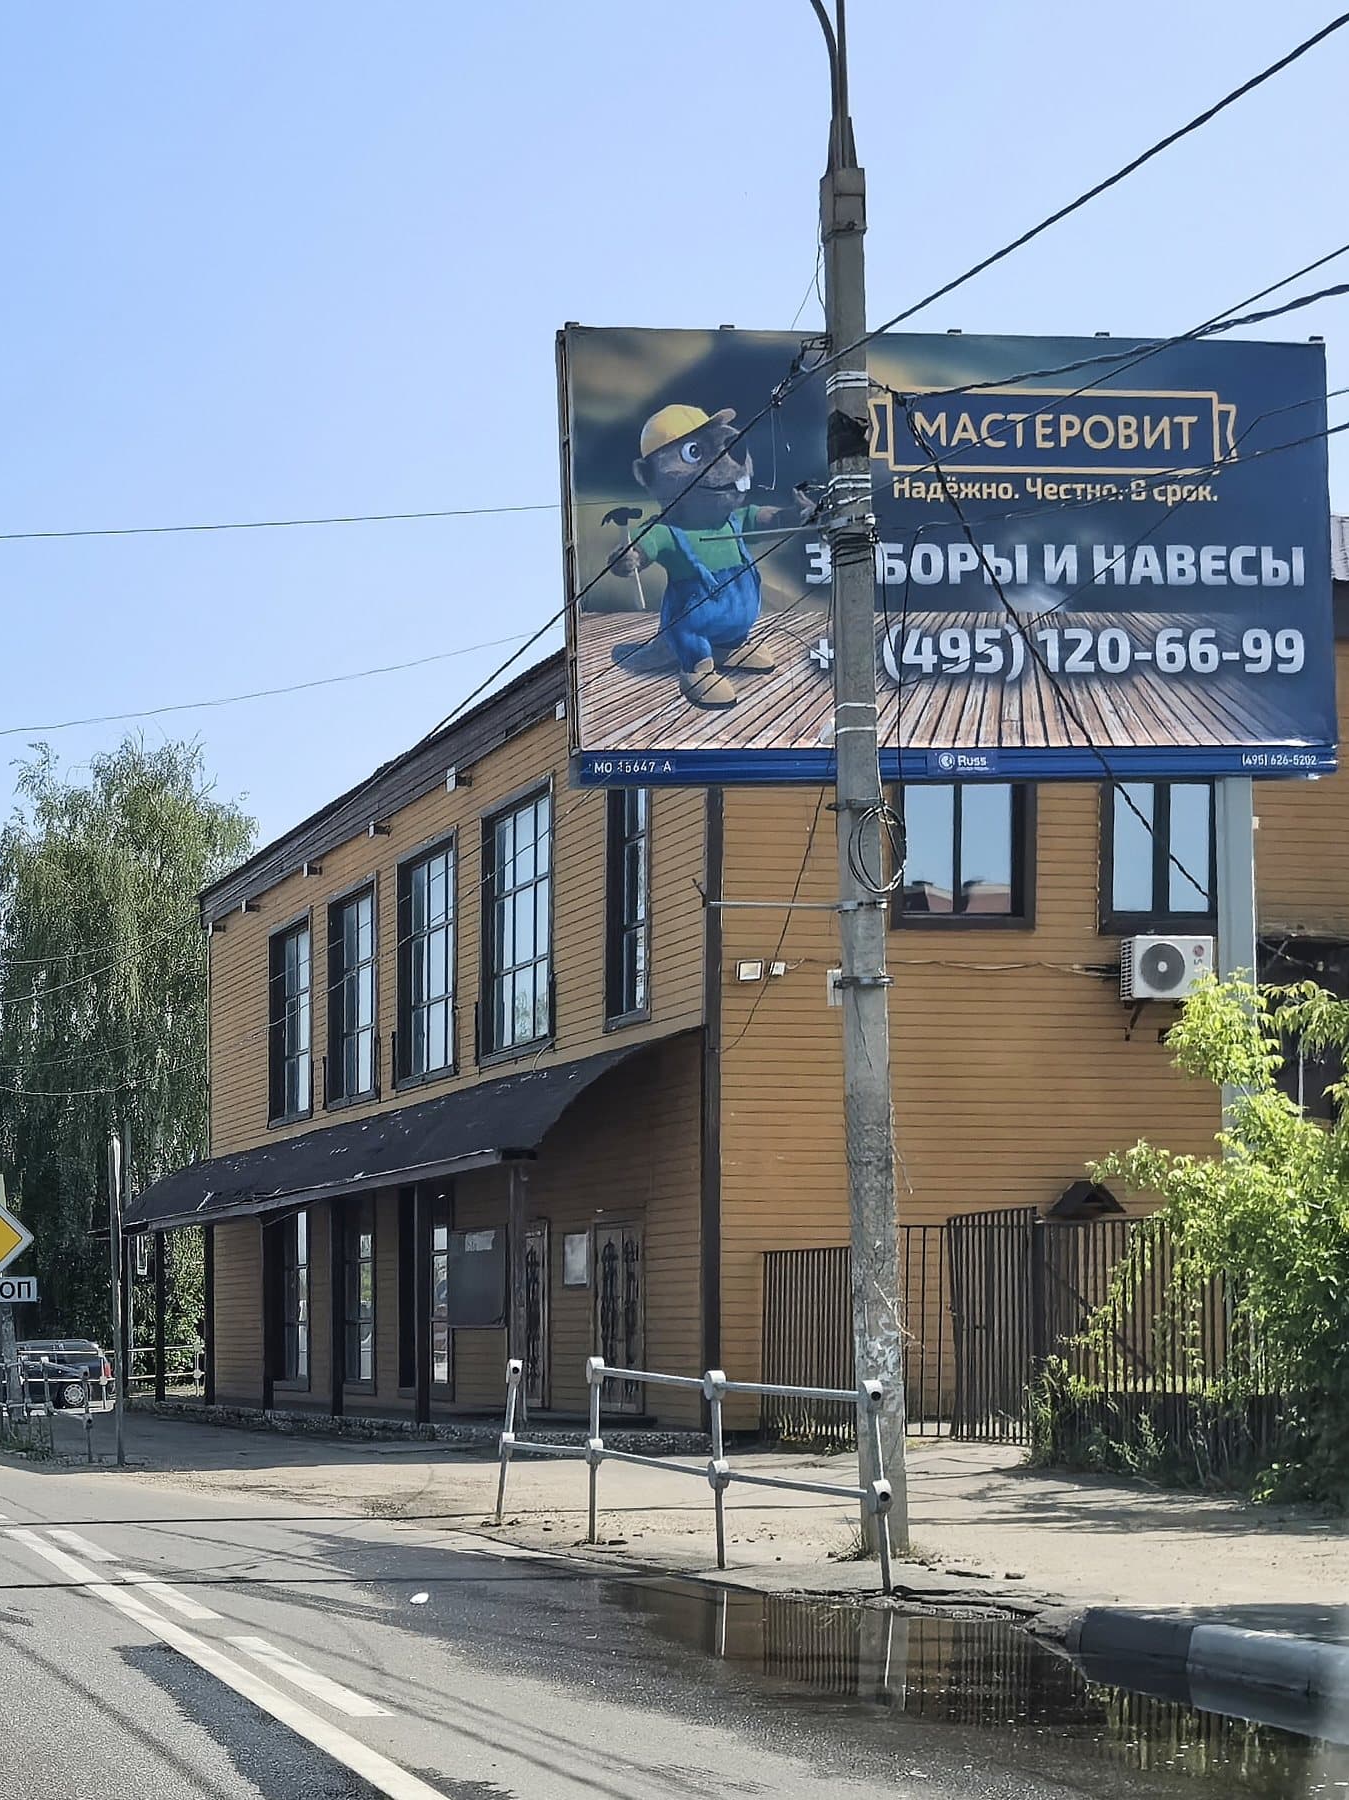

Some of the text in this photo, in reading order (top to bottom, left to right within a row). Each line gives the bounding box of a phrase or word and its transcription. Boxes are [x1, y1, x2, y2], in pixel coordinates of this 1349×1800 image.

[914, 411, 1198, 451] МАСТЕРОВИТ
[893, 476, 1218, 507] Надёжно. Честно. В срок.
[805, 543, 1305, 586] ЗБОРЫ И НАВЕСЫ
[882, 623, 1025, 683] (495)
[1037, 627, 1305, 674] 120-66-99
[957, 755, 987, 766] Russ
[1242, 753, 1318, 767] (495) 626-5202
